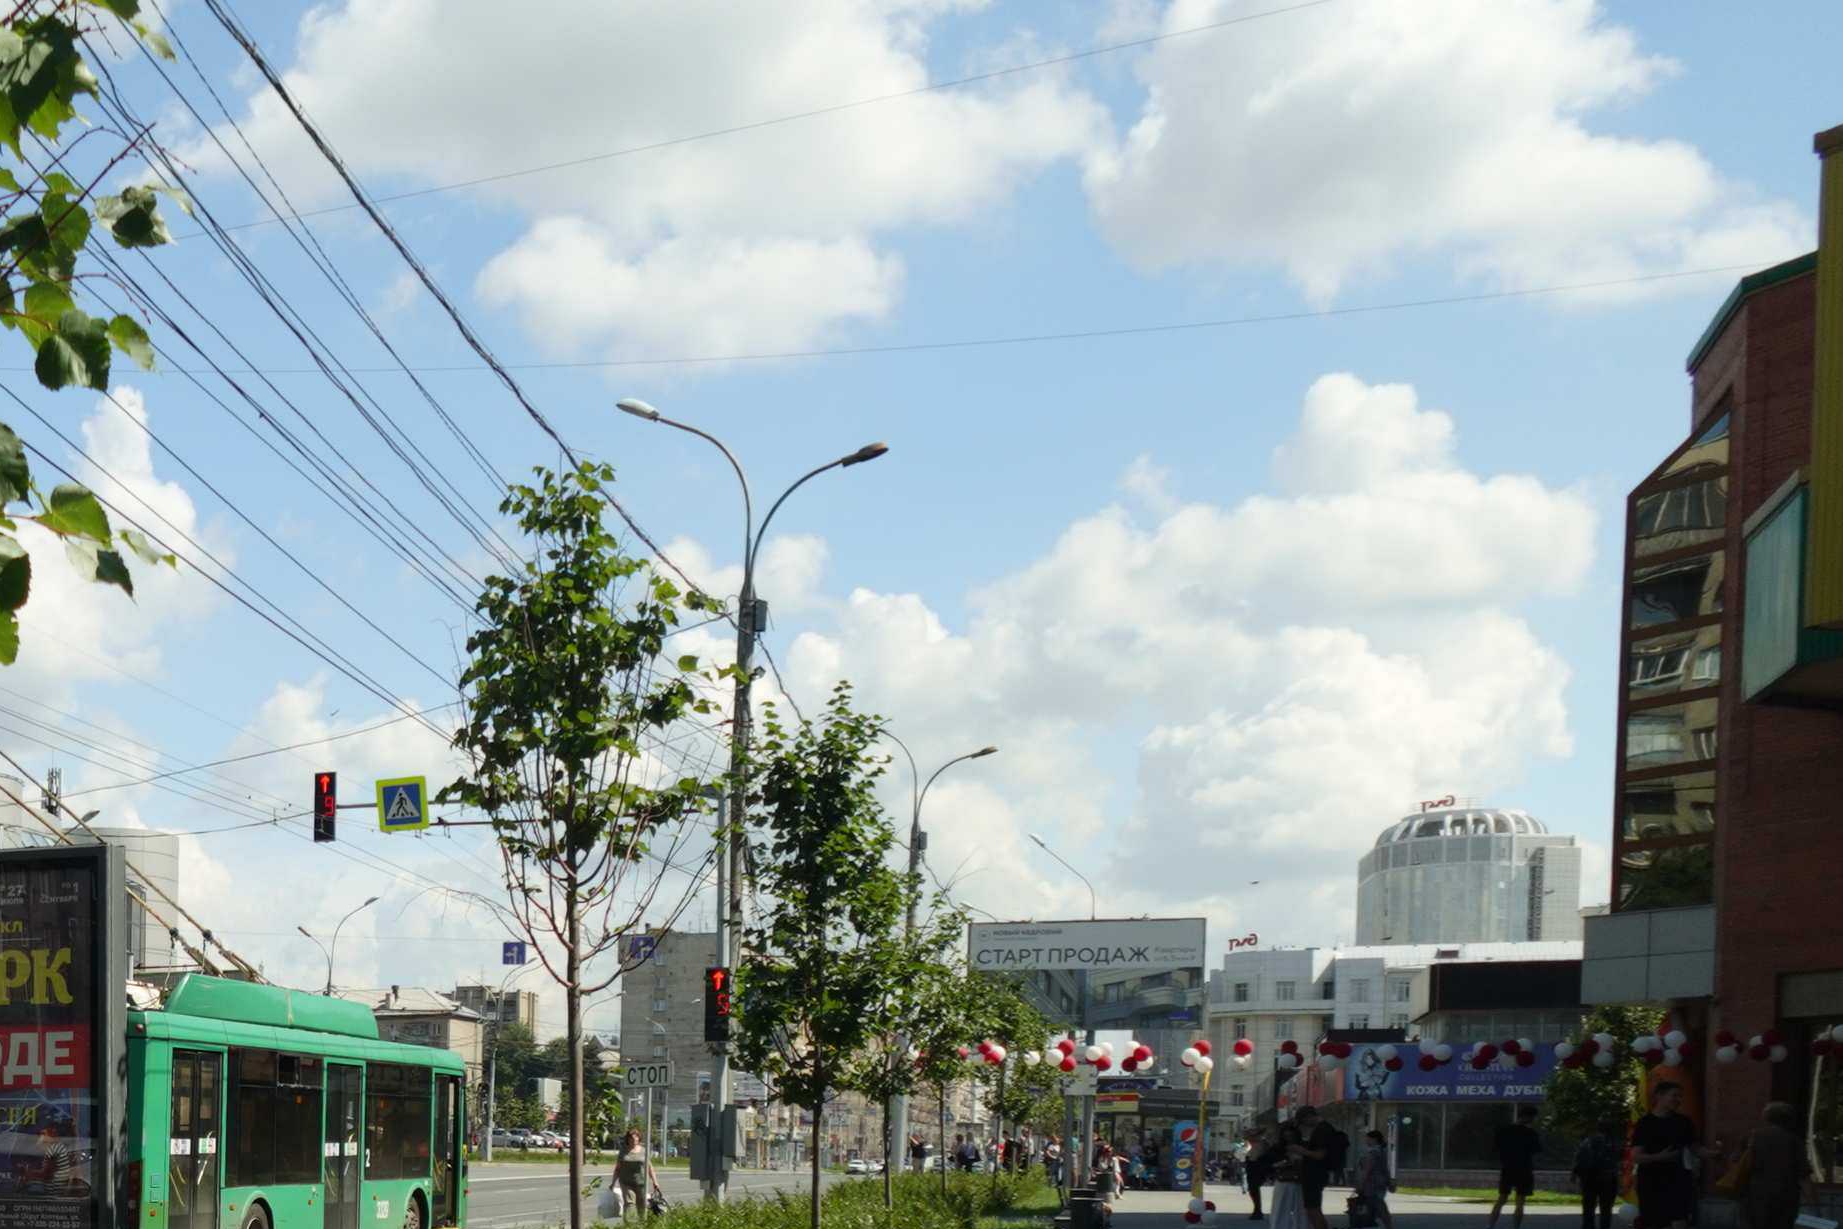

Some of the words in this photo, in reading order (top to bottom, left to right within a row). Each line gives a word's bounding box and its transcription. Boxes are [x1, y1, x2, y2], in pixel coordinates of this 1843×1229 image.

[8, 884, 25, 897] 27
[976, 949, 1044, 965] СТАРТ
[1048, 946, 1150, 966] ПРОДАЖ
[627, 1065, 669, 1085] СТОП
[1406, 1085, 1449, 1096] КОЖА
[1456, 1085, 1497, 1096] МЕХА
[1503, 1085, 1544, 1097] ДУБЛ
